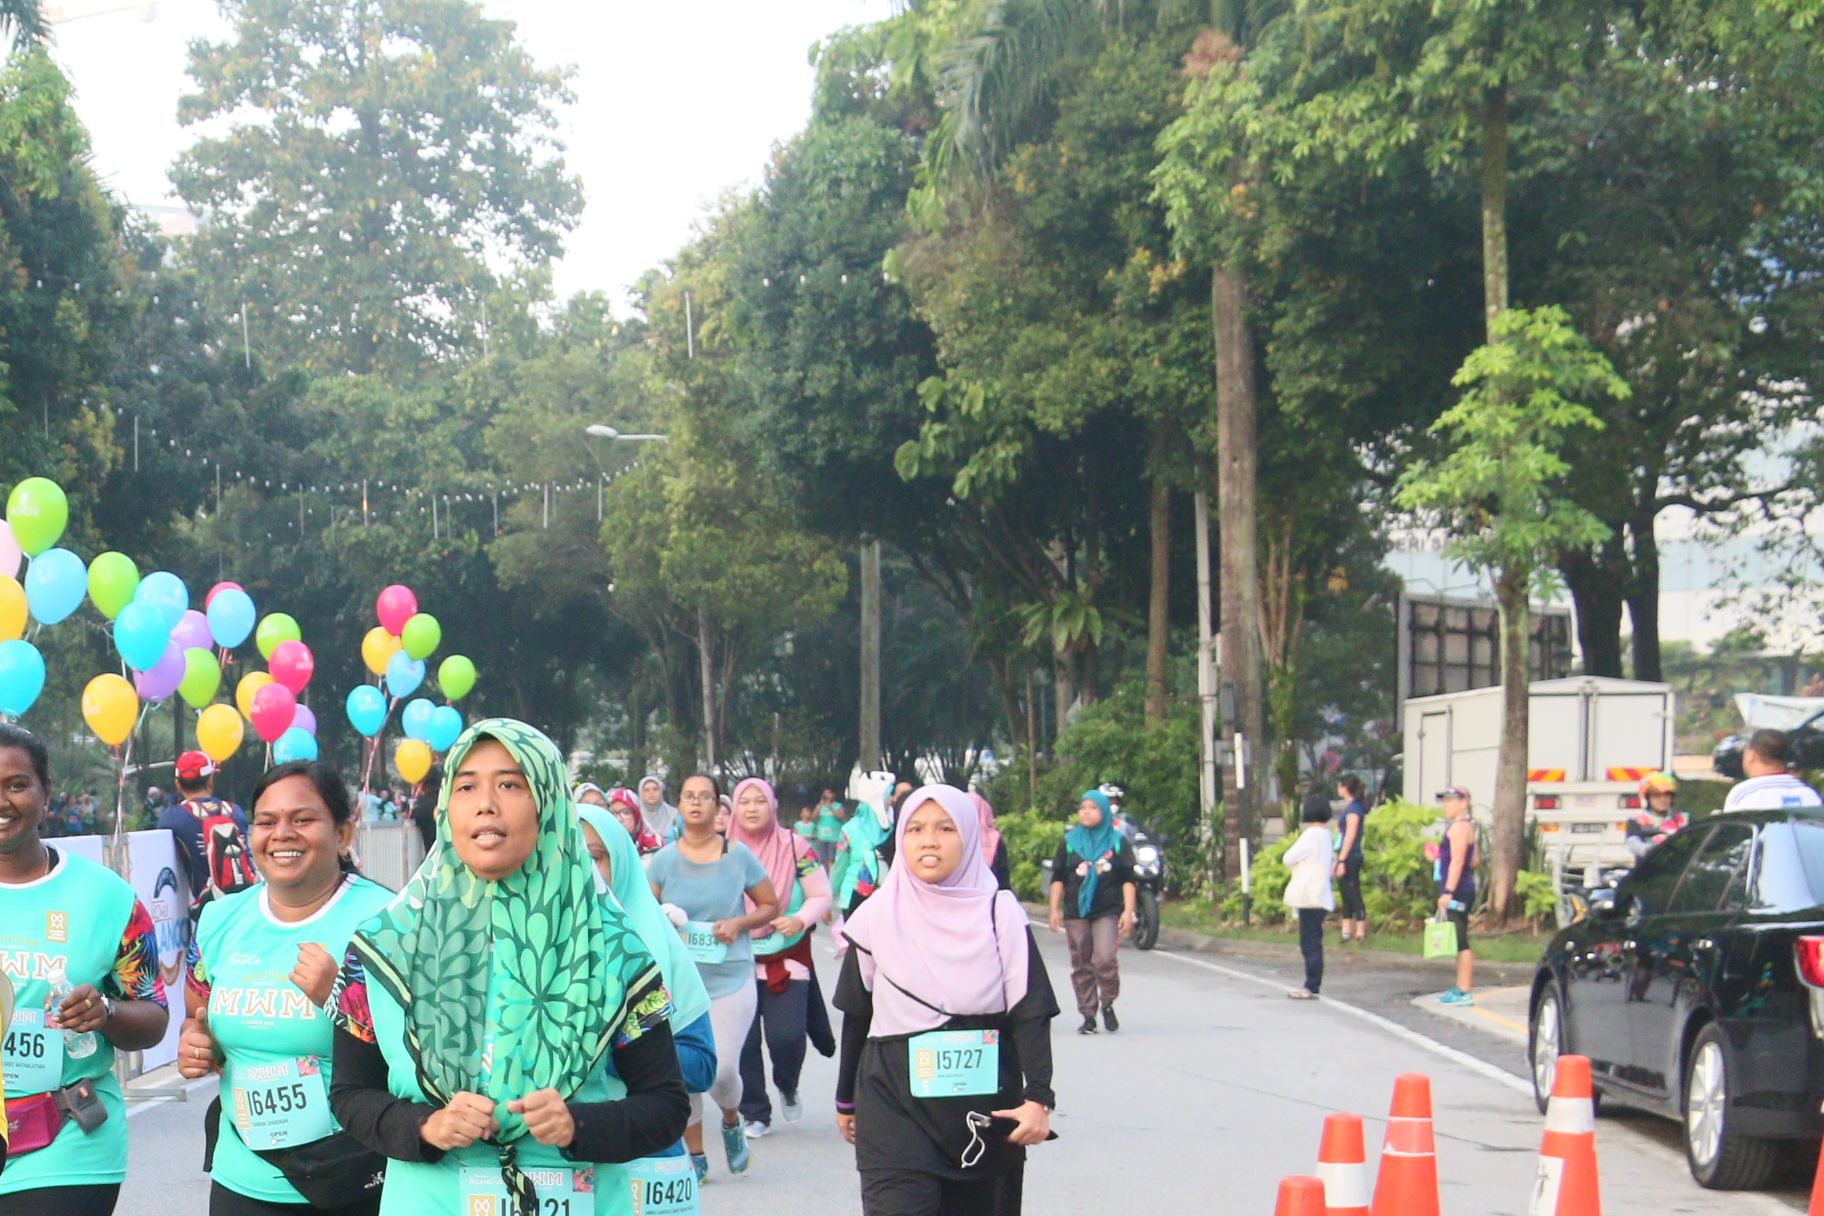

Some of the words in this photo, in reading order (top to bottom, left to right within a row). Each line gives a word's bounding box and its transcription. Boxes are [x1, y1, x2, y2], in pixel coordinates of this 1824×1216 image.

[212, 987, 316, 1020] MWM
[937, 1049, 982, 1070] 15727
[247, 1083, 307, 1117] 16455
[646, 1177, 692, 1205] 16420
